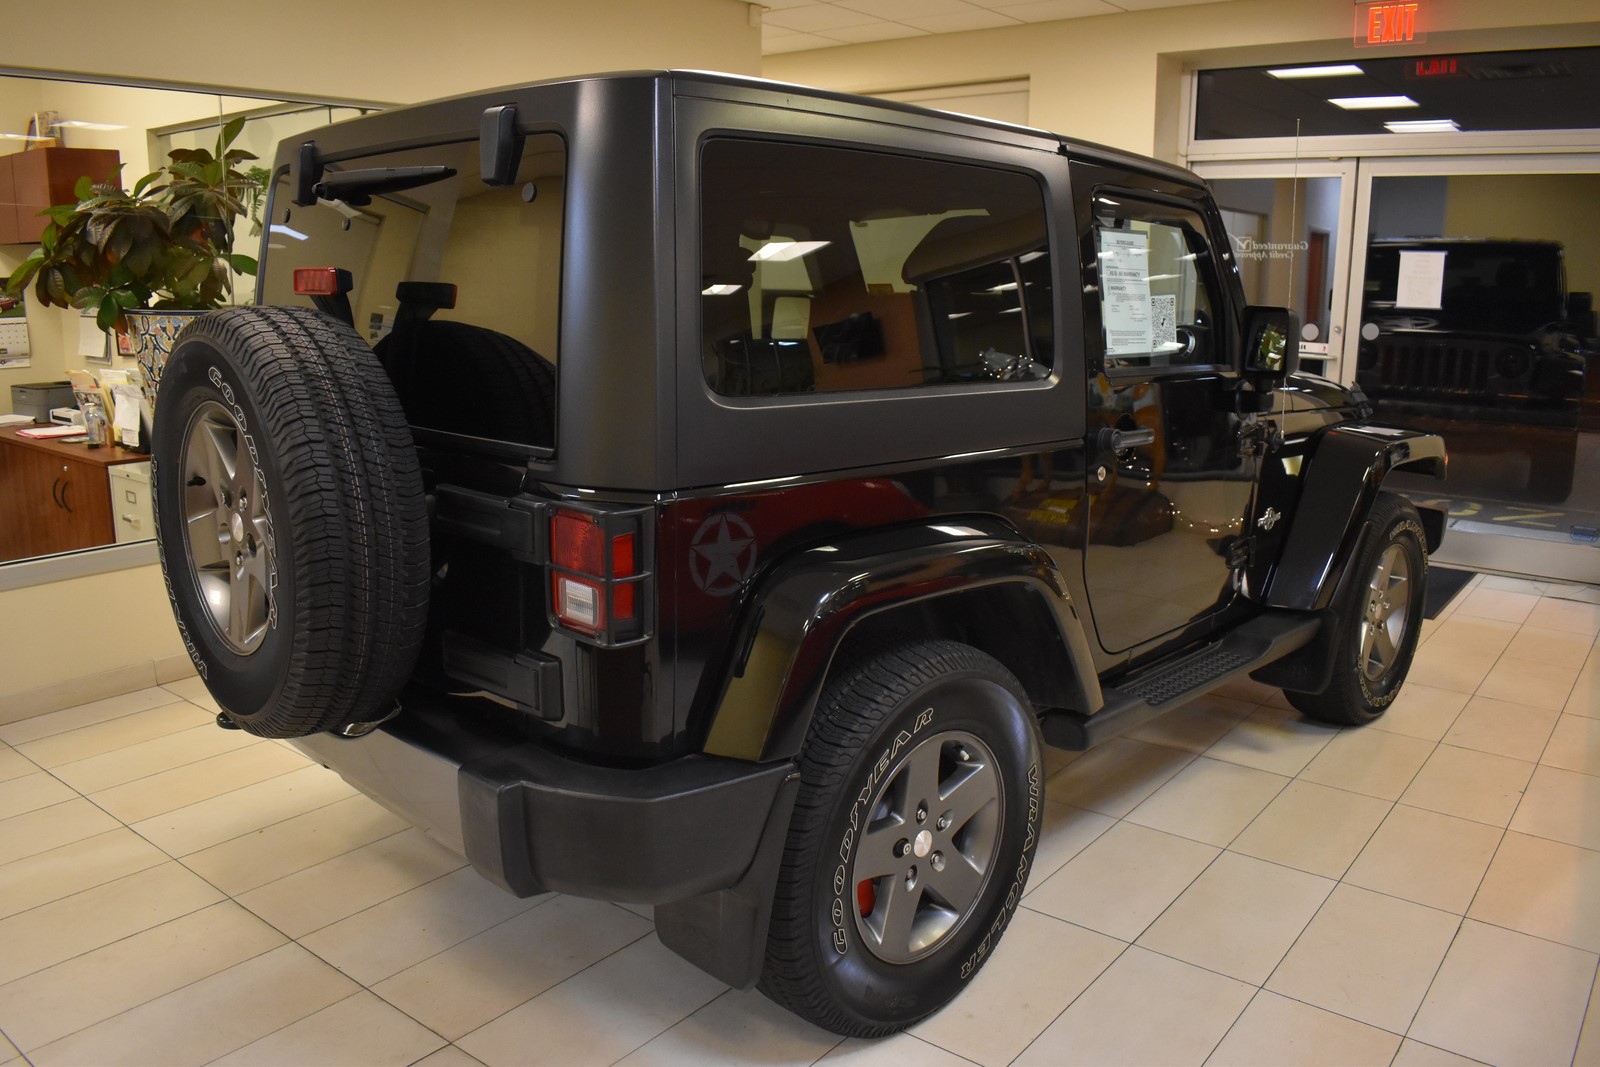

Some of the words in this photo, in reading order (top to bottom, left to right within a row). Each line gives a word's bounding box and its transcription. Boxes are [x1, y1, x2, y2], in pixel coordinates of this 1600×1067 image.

[1368, 4, 1418, 43] EXIT
[208, 366, 279, 630] GOODYEAR
[831, 707, 934, 955] GOODYEAR
[960, 764, 1039, 980] WRANGLER
